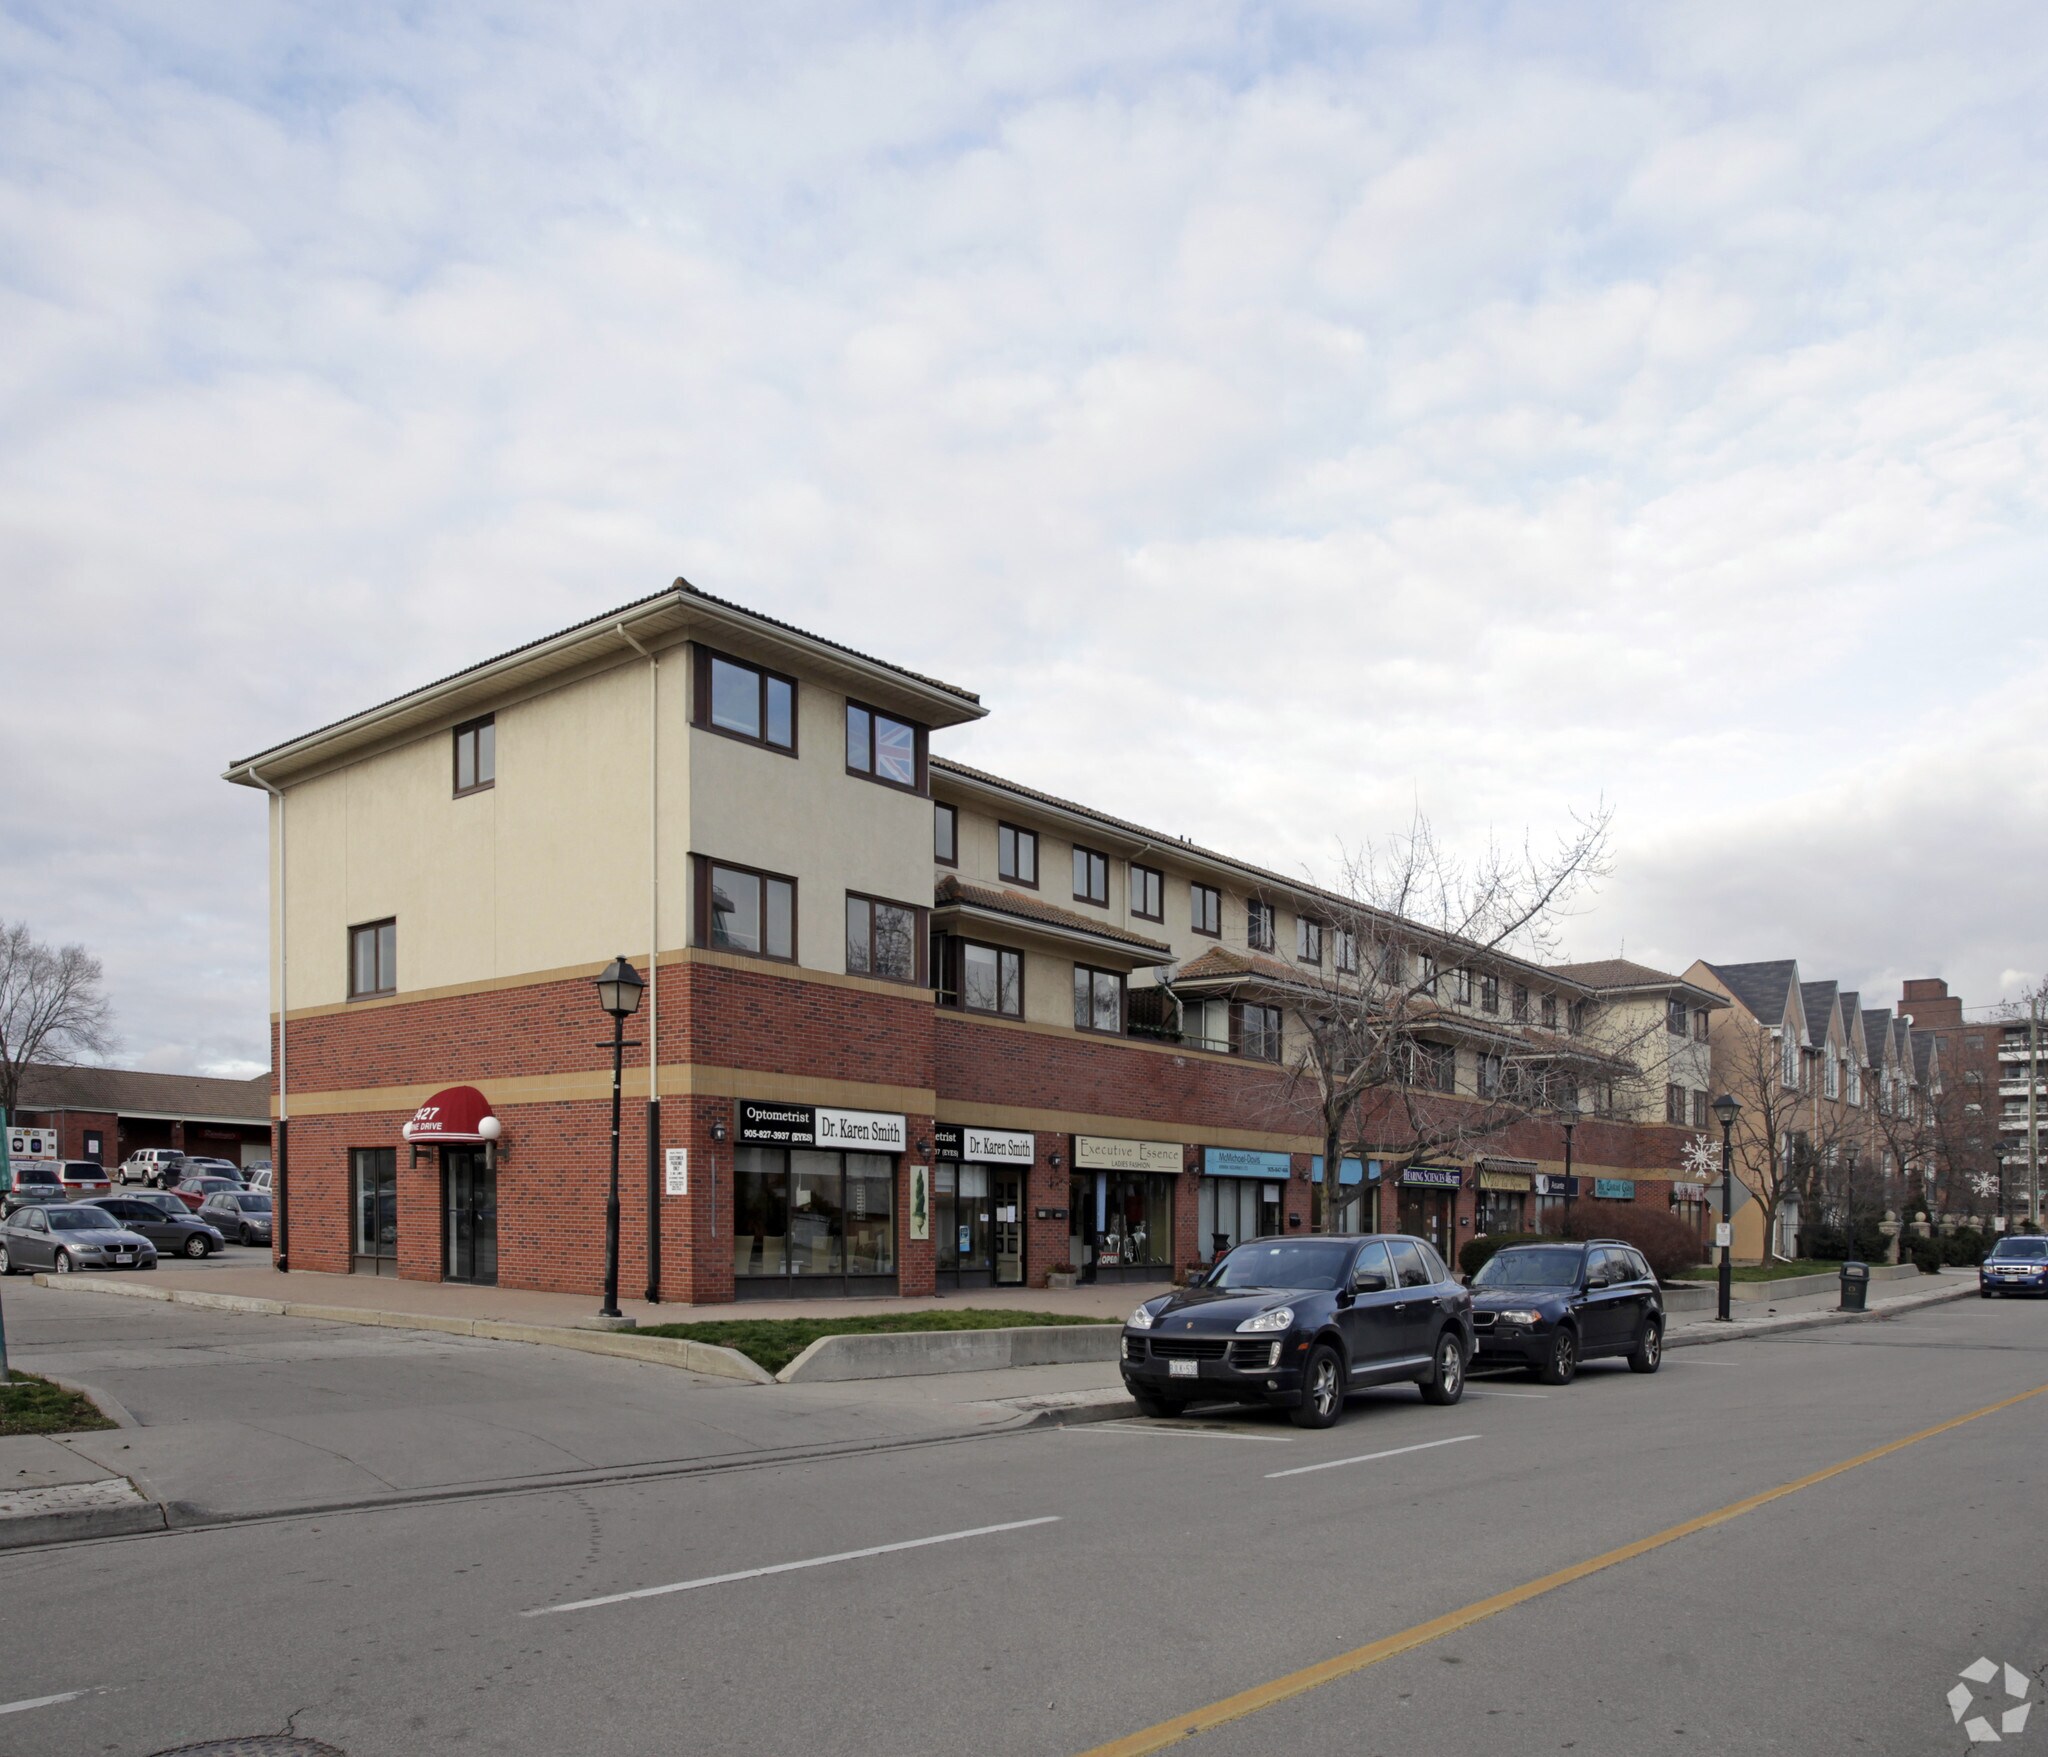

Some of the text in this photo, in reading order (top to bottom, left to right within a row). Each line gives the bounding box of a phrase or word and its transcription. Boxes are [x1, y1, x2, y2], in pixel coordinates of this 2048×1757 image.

[413, 1107, 440, 1121] 427
[746, 1106, 810, 1123] Optometrist
[420, 1122, 443, 1130] DRIVE
[822, 1116, 900, 1142] Dr. Karen Smith
[935, 1131, 957, 1142] etrist
[970, 1136, 1031, 1157] Dr. Karen Smith
[1081, 1138, 1179, 1161] Executive Essence
[1111, 1160, 1151, 1169] LADIES FASHION
[1101, 1255, 1118, 1264] OPEN
